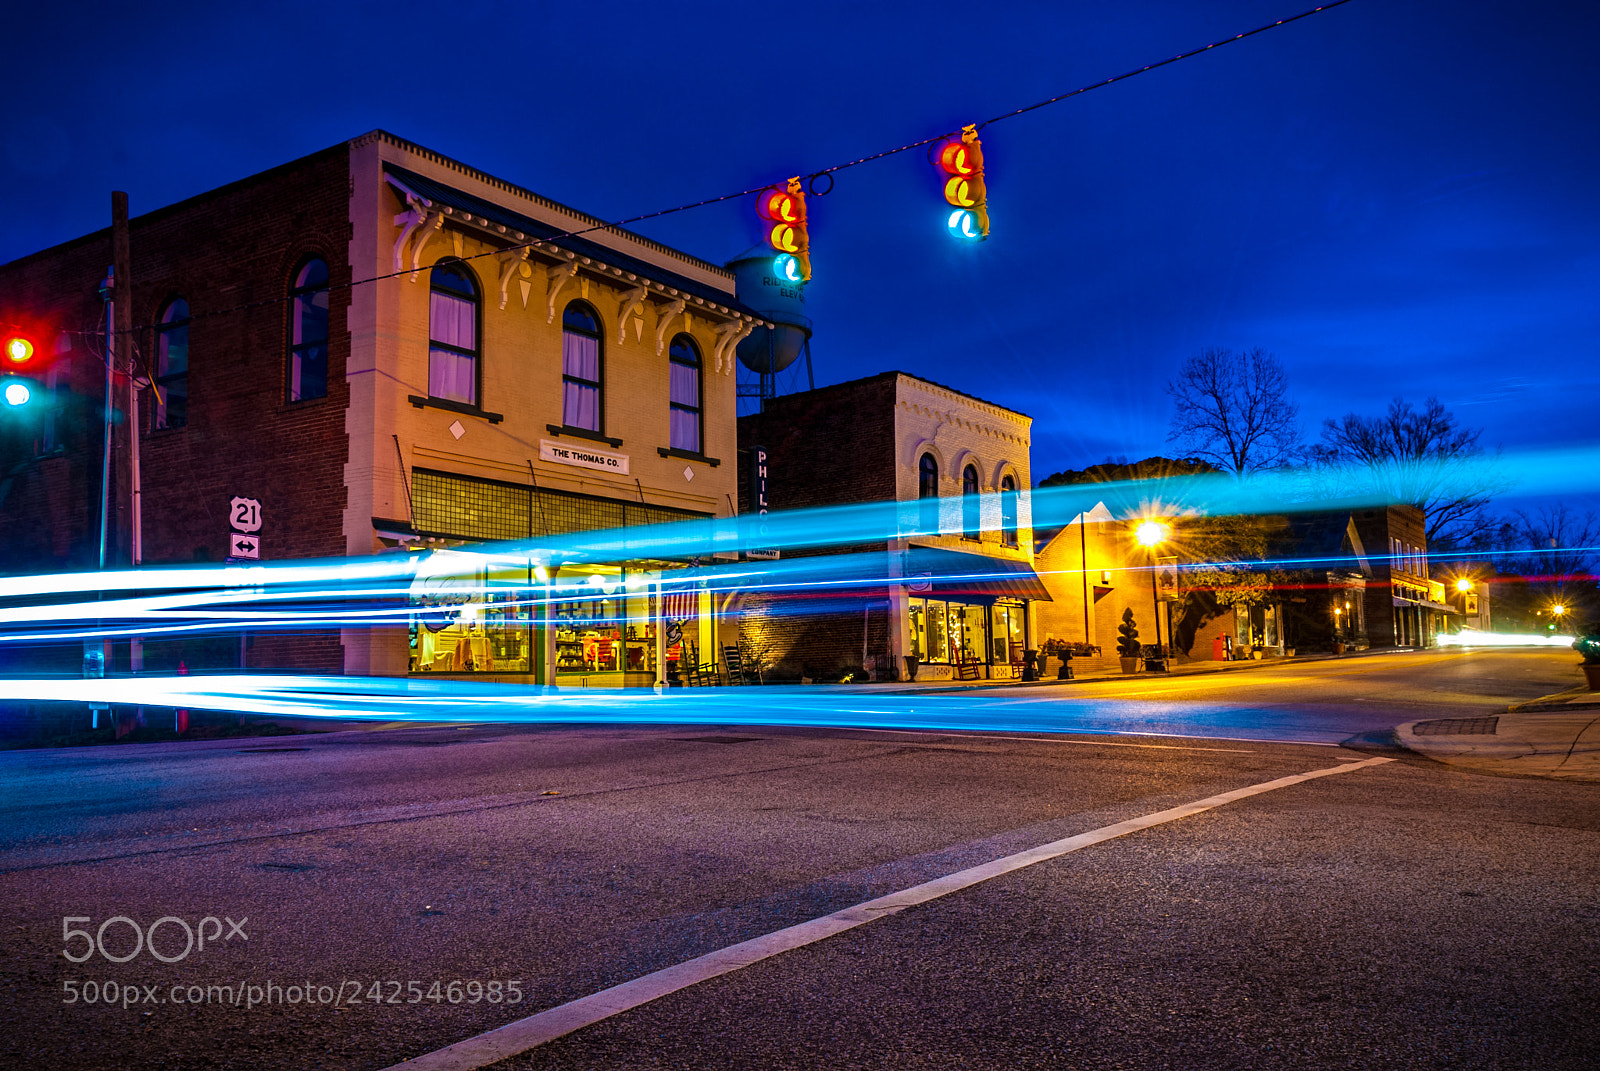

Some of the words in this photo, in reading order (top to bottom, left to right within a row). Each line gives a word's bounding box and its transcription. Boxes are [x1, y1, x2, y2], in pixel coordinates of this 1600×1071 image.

[552, 448, 570, 458] THE
[571, 451, 605, 465] THOMAS
[606, 458, 620, 468] CO.
[236, 503, 256, 525] 21
